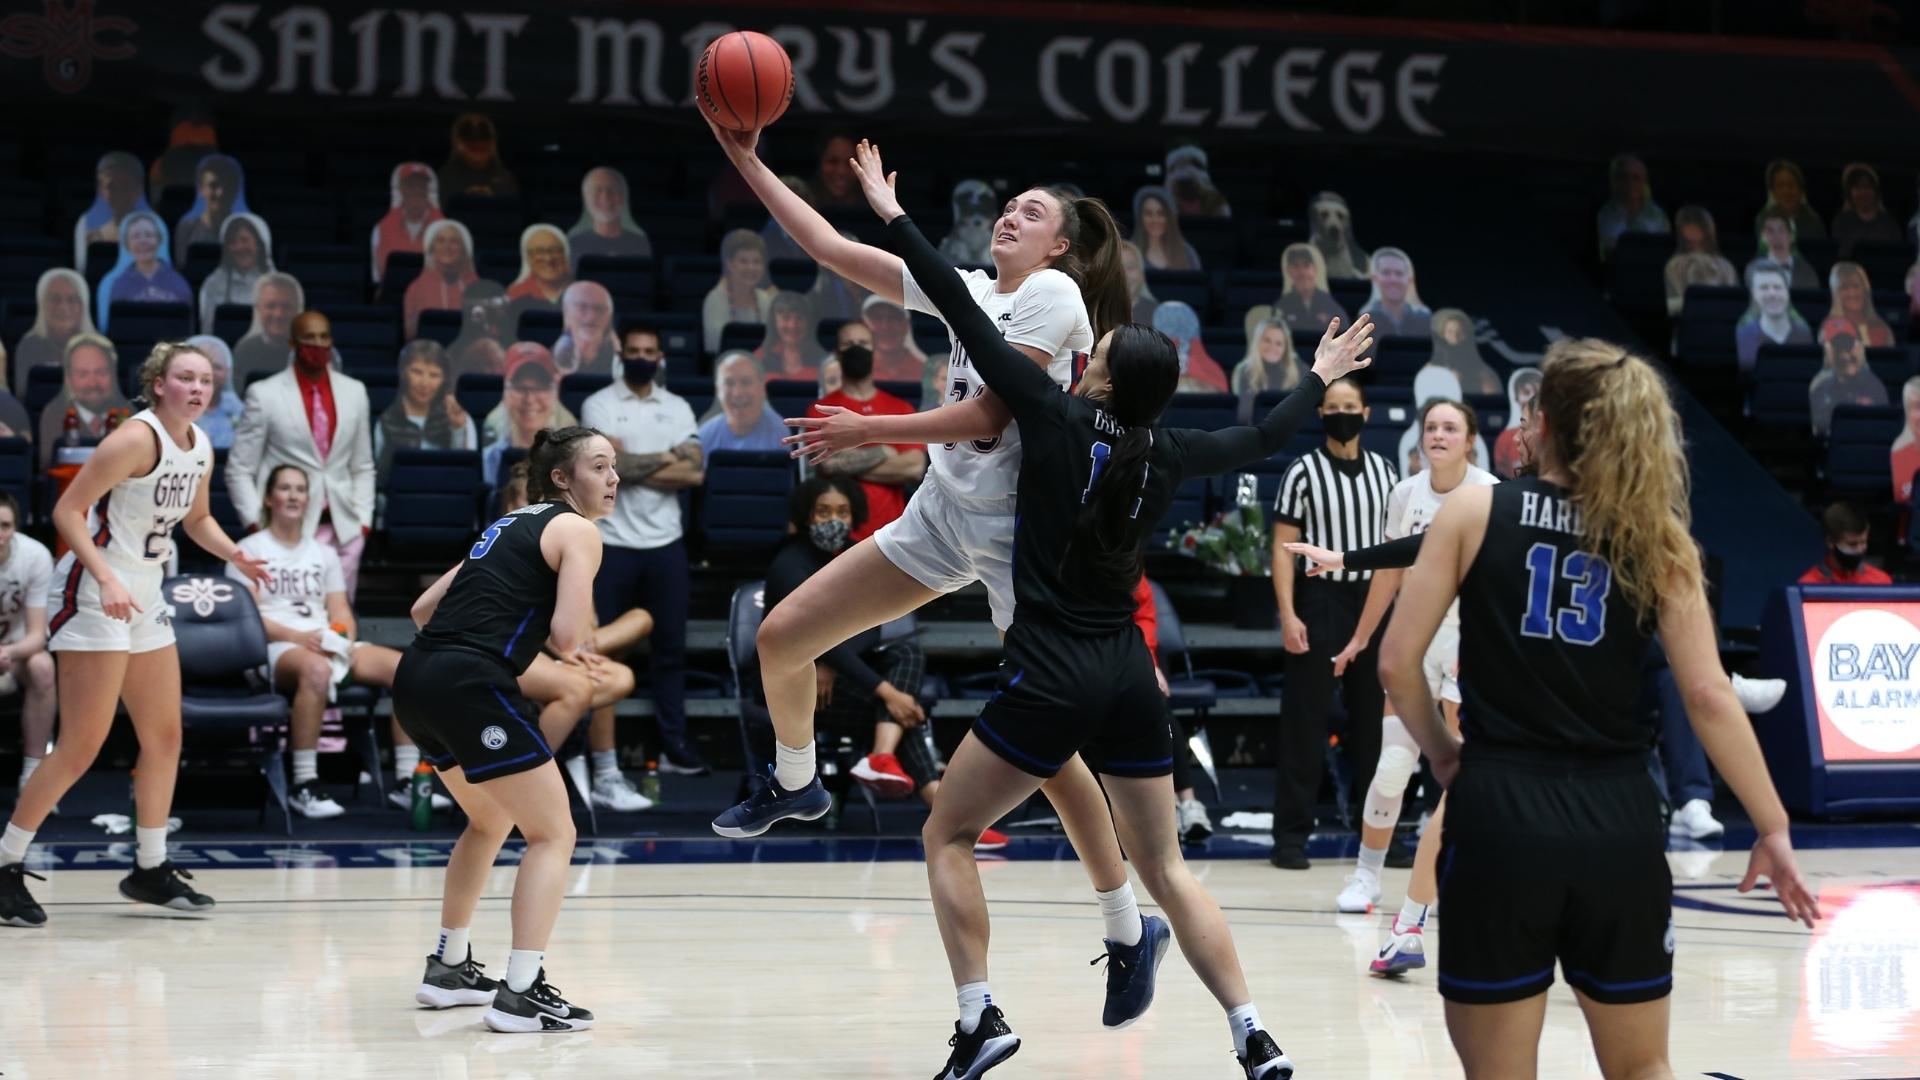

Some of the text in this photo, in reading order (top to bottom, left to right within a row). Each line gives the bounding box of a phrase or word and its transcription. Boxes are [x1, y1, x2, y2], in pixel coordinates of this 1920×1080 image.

[200, 3, 529, 101] SAINT
[1037, 35, 1448, 138] COLLEGE
[154, 472, 203, 508] GAEL
[469, 516, 518, 560] 5
[1519, 541, 1612, 647] 13
[1828, 643, 1920, 681] BAY
[1831, 688, 1920, 709] ALARM
